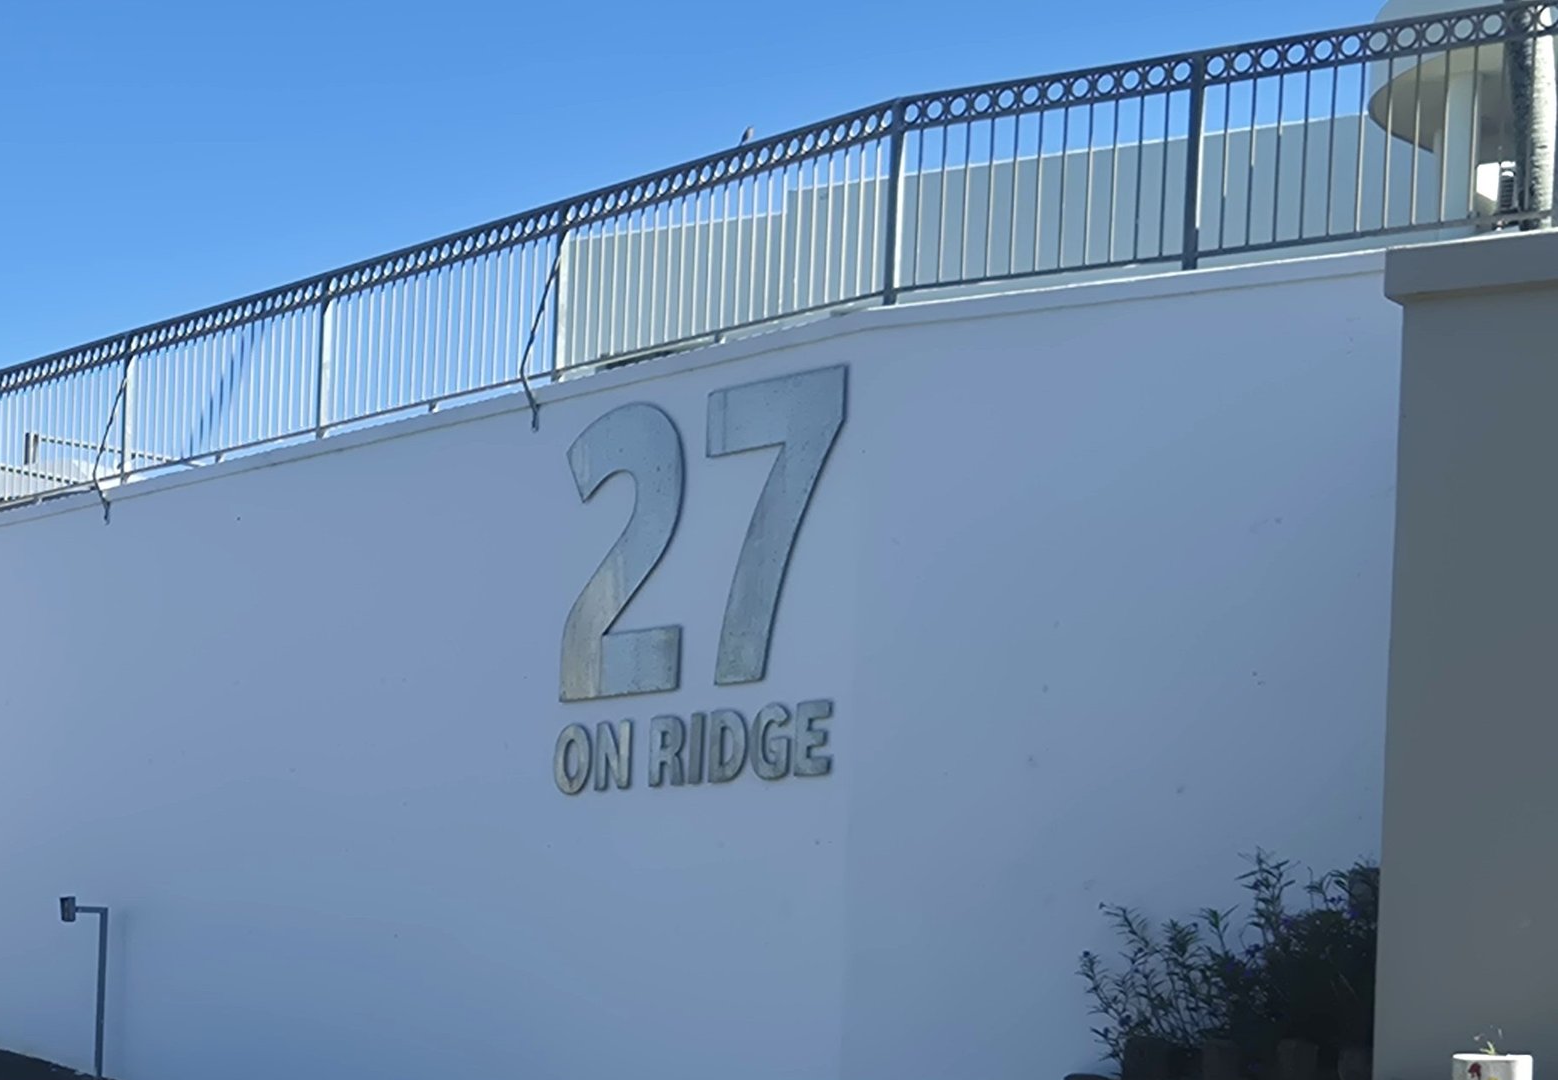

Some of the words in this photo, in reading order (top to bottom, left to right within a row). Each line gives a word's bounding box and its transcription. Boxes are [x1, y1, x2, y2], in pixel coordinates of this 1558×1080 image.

[559, 364, 849, 702] 27
[554, 719, 633, 795] ON
[648, 699, 833, 787] RIDGE
